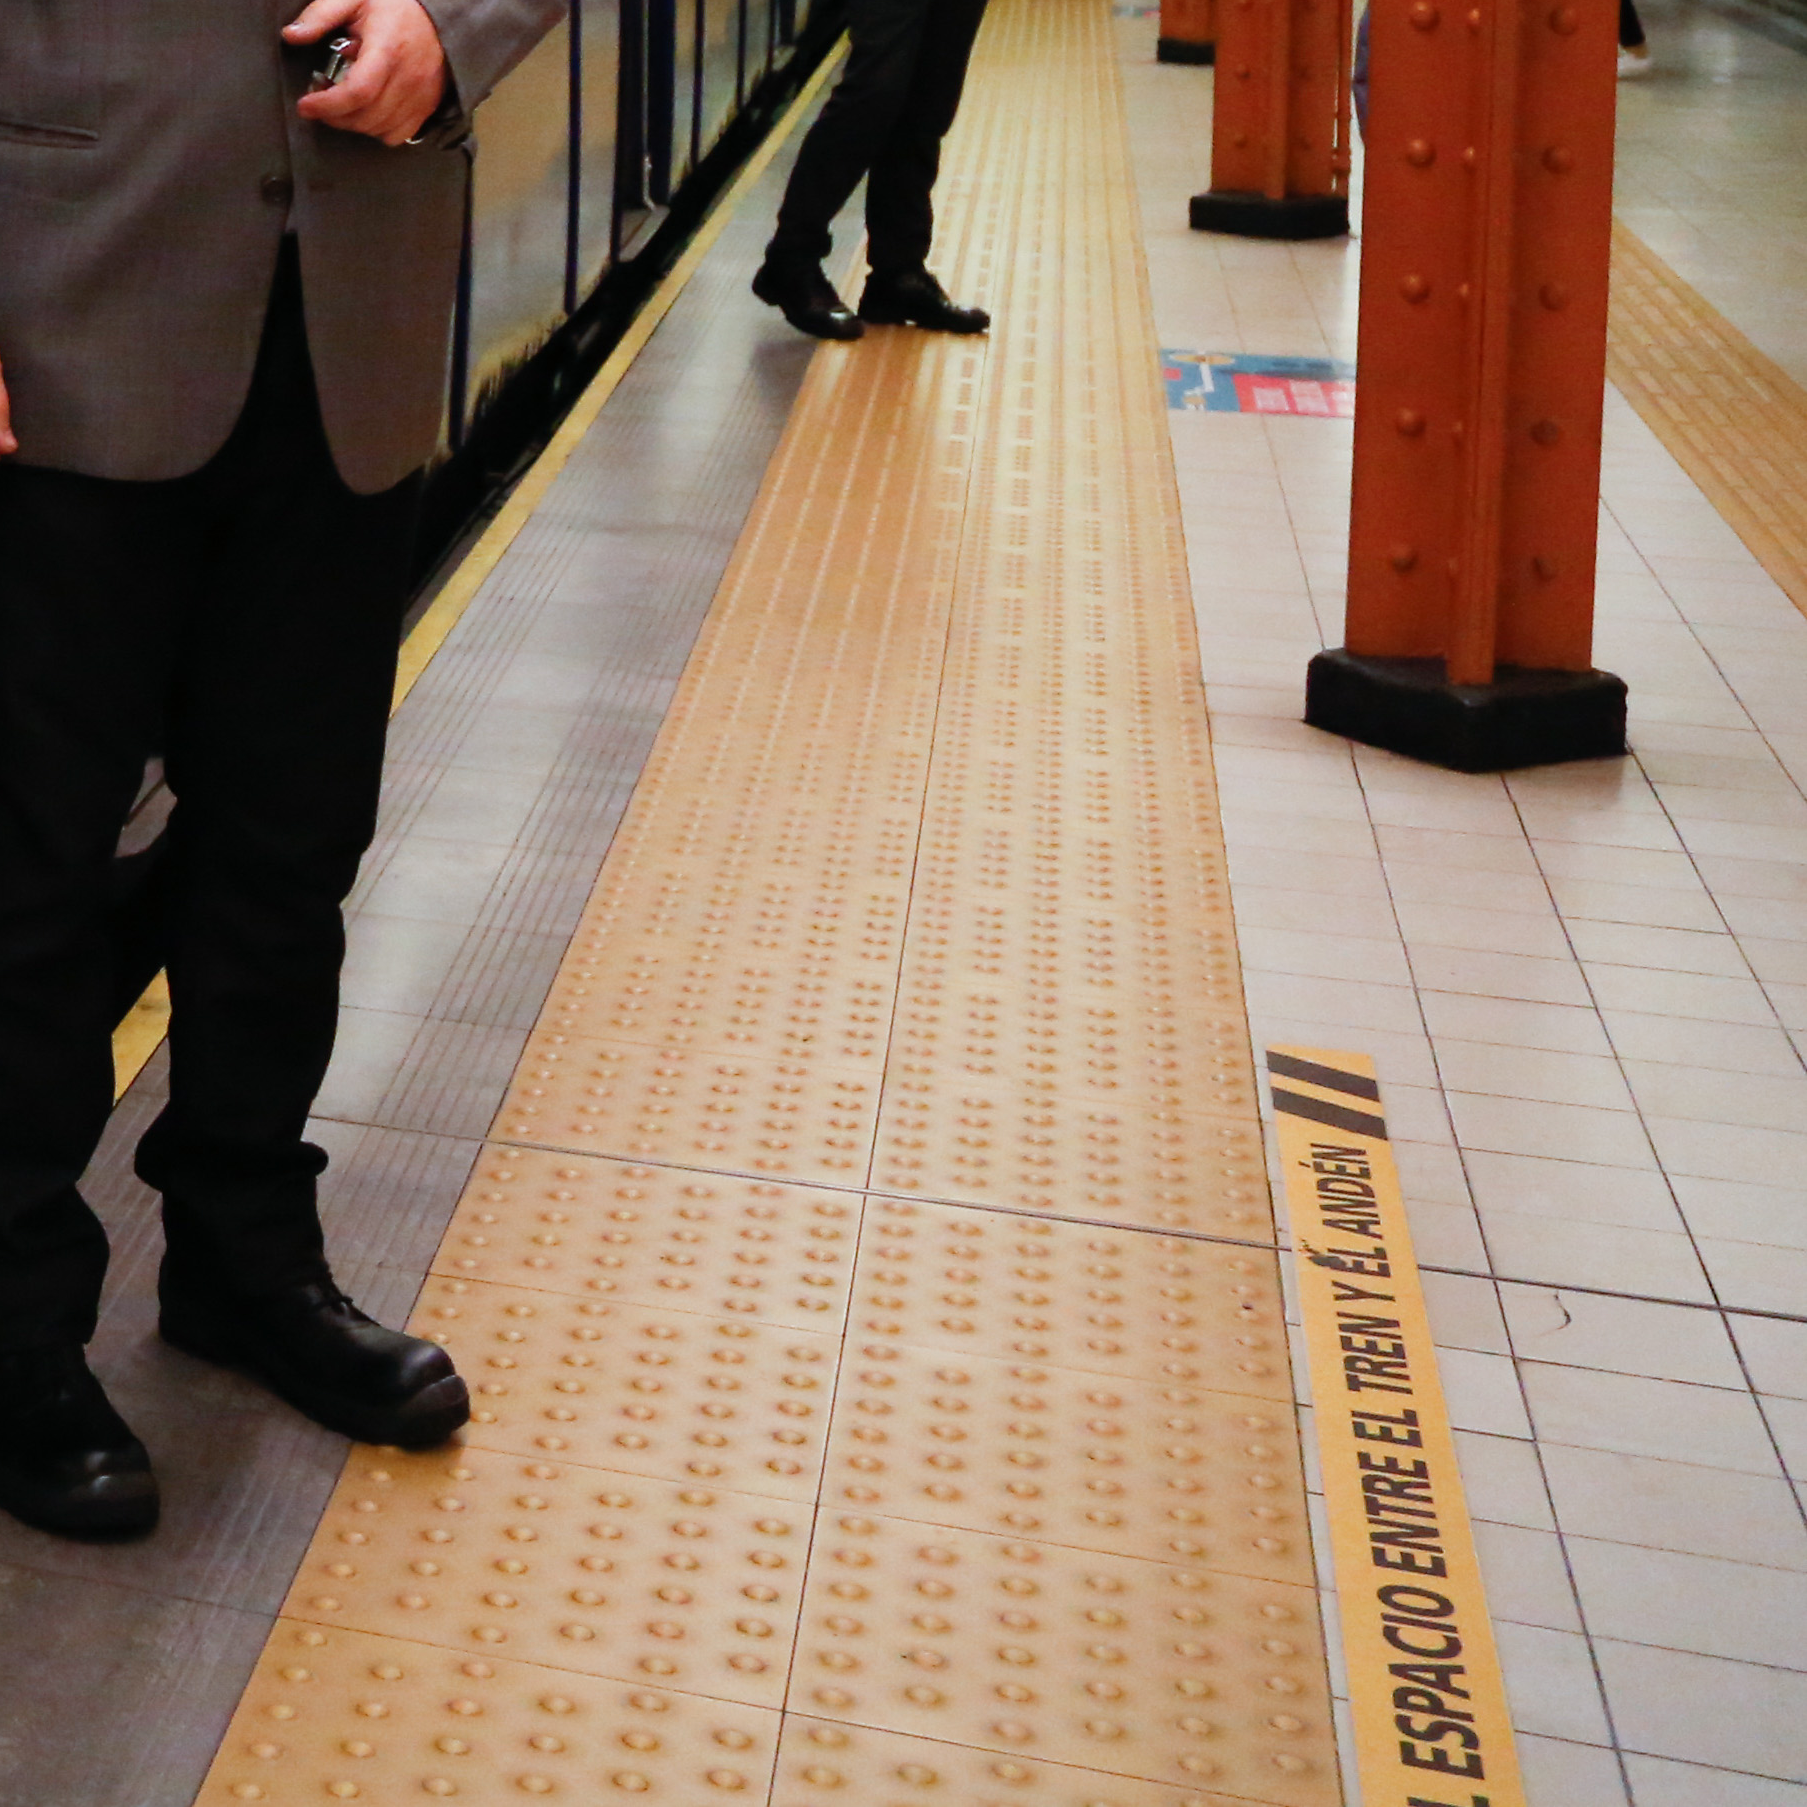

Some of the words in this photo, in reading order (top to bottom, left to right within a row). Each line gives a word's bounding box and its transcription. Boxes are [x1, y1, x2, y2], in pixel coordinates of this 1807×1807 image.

[1297, 1142, 1384, 1240] ANDÉN
[1325, 1246, 1392, 1279] EL
[1331, 1279, 1397, 1303] Y
[1335, 1310, 1414, 1396] TREN
[1350, 1407, 1424, 1449] EL
[1356, 1450, 1448, 1580] ENTRE
[1376, 1583, 1486, 1781] ESPACIO
